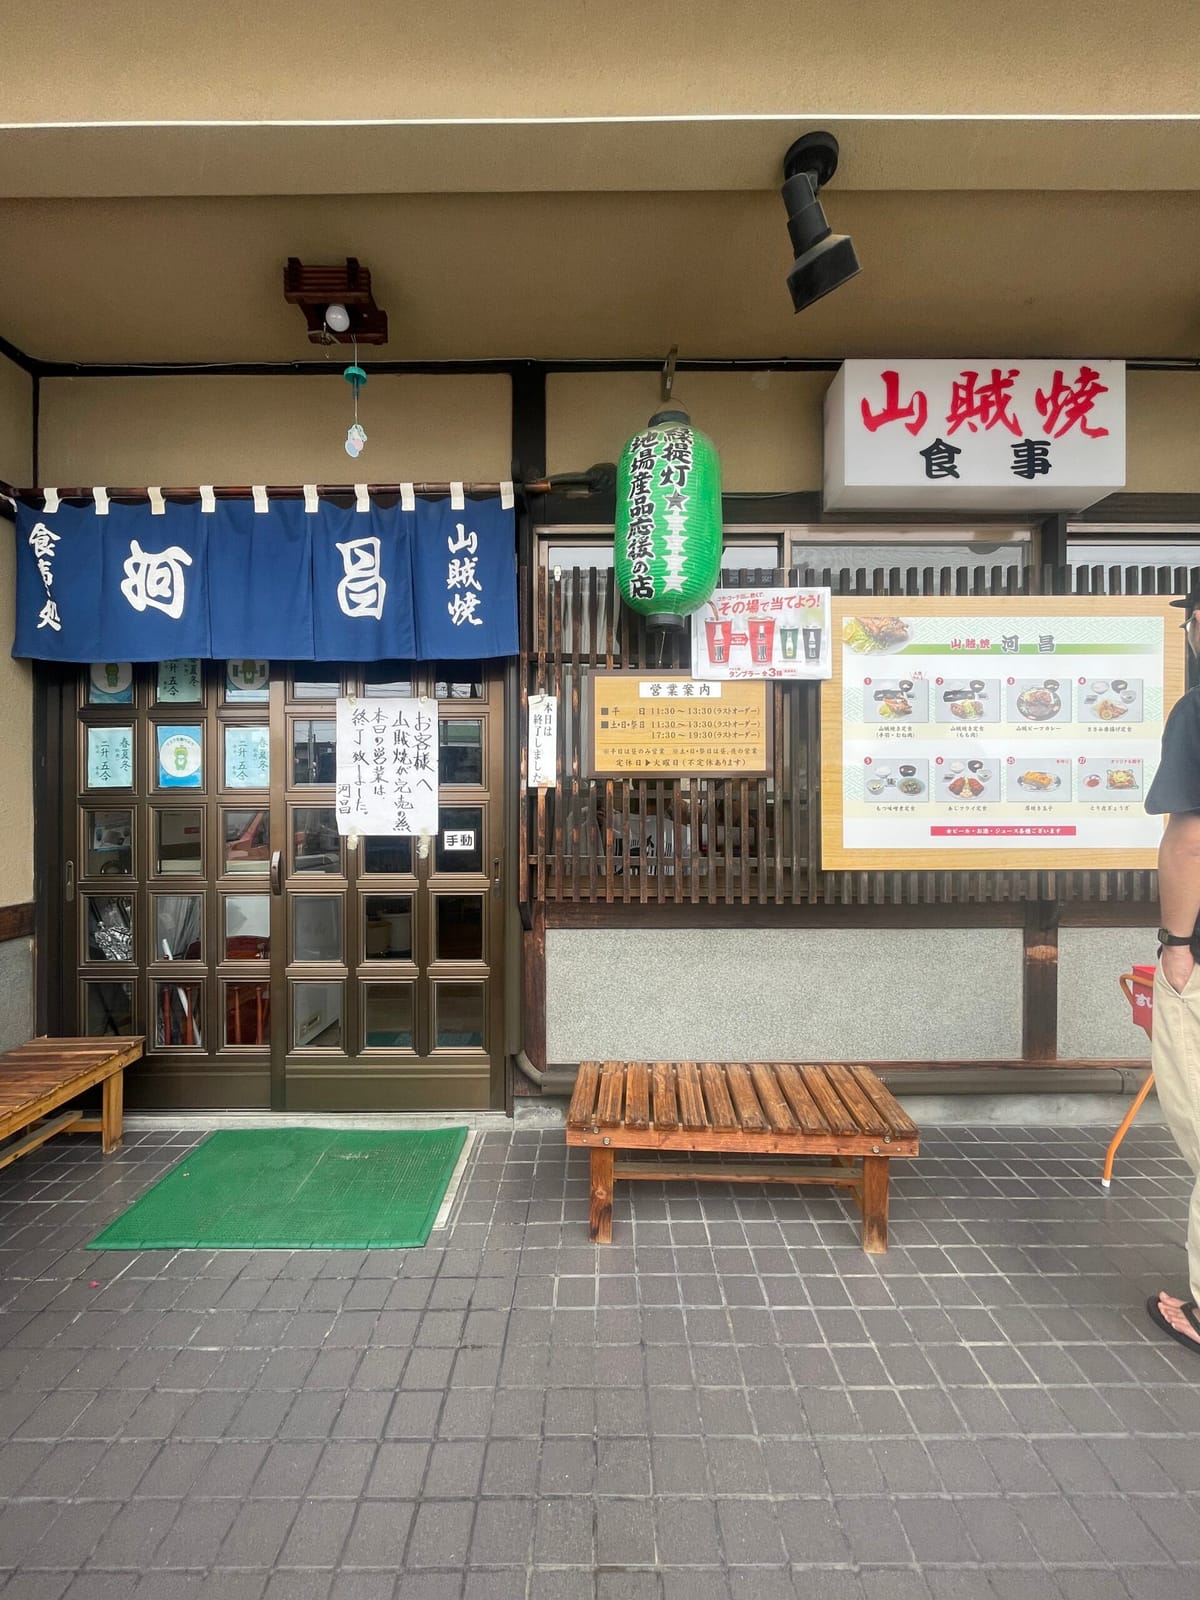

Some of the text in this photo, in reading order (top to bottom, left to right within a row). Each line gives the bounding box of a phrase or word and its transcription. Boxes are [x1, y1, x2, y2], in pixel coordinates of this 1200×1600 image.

[860, 366, 1110, 439] 山賊焼
[659, 428, 694, 487] 緑提灯
[919, 437, 1052, 480] 食事
[627, 430, 659, 600] 地場産品応援の店
[120, 537, 387, 621] 河 昌
[446, 523, 483, 627] 山賊焼
[718, 594, 821, 616] その場で当てよう!
[1001, 634, 1056, 655] 河昌
[650, 683, 711, 697] 営業案内
[729, 670, 761, 678] タンブラー
[543, 703, 553, 736] 本日は
[99, 741, 111, 781] 二升五合
[120, 736, 131, 772] 春夏冬
[412, 711, 435, 792] お客様へ
[532, 713, 542, 783] 終了しました
[338, 783, 351, 814] 河昌
[446, 834, 473, 847] 手動
